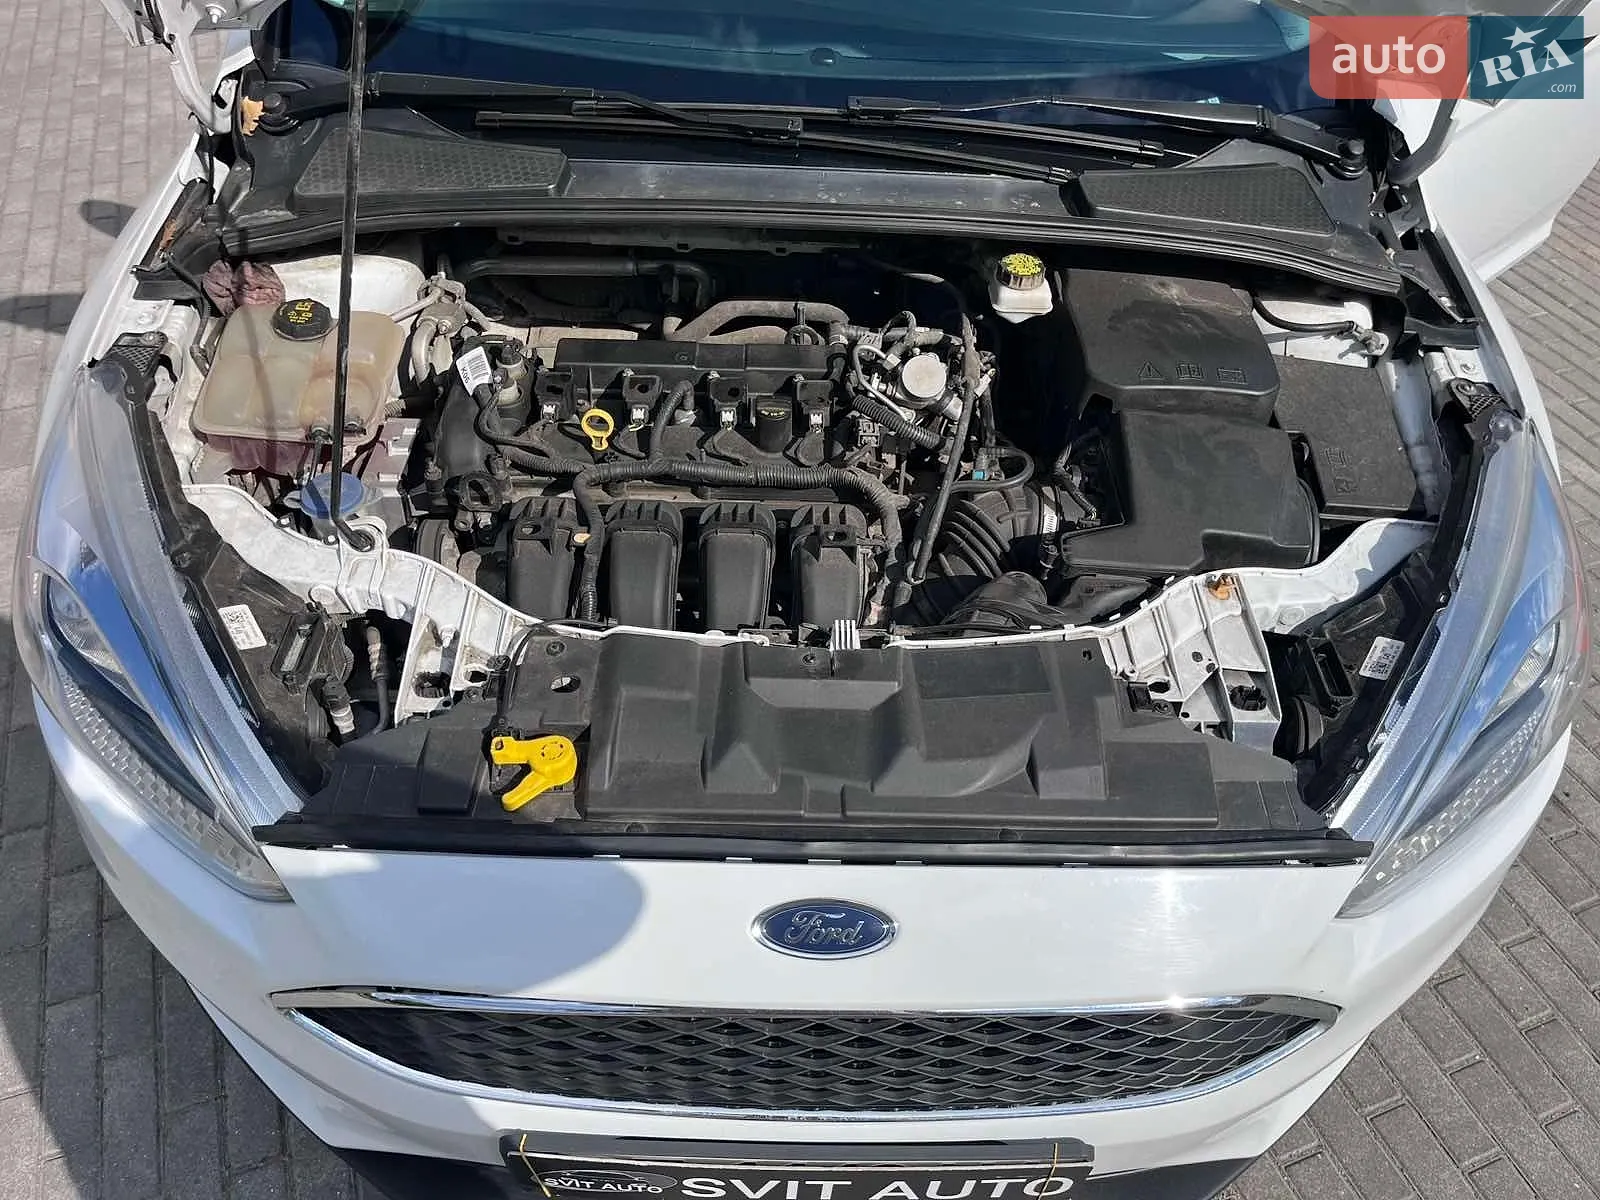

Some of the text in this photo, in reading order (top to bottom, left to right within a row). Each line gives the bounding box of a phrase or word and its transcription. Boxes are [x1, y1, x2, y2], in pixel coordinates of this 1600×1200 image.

[784, 910, 865, 944] Ford
[544, 1177, 663, 1194] SVIT AUTO
[681, 1177, 1074, 1200] SVIT AUTO
